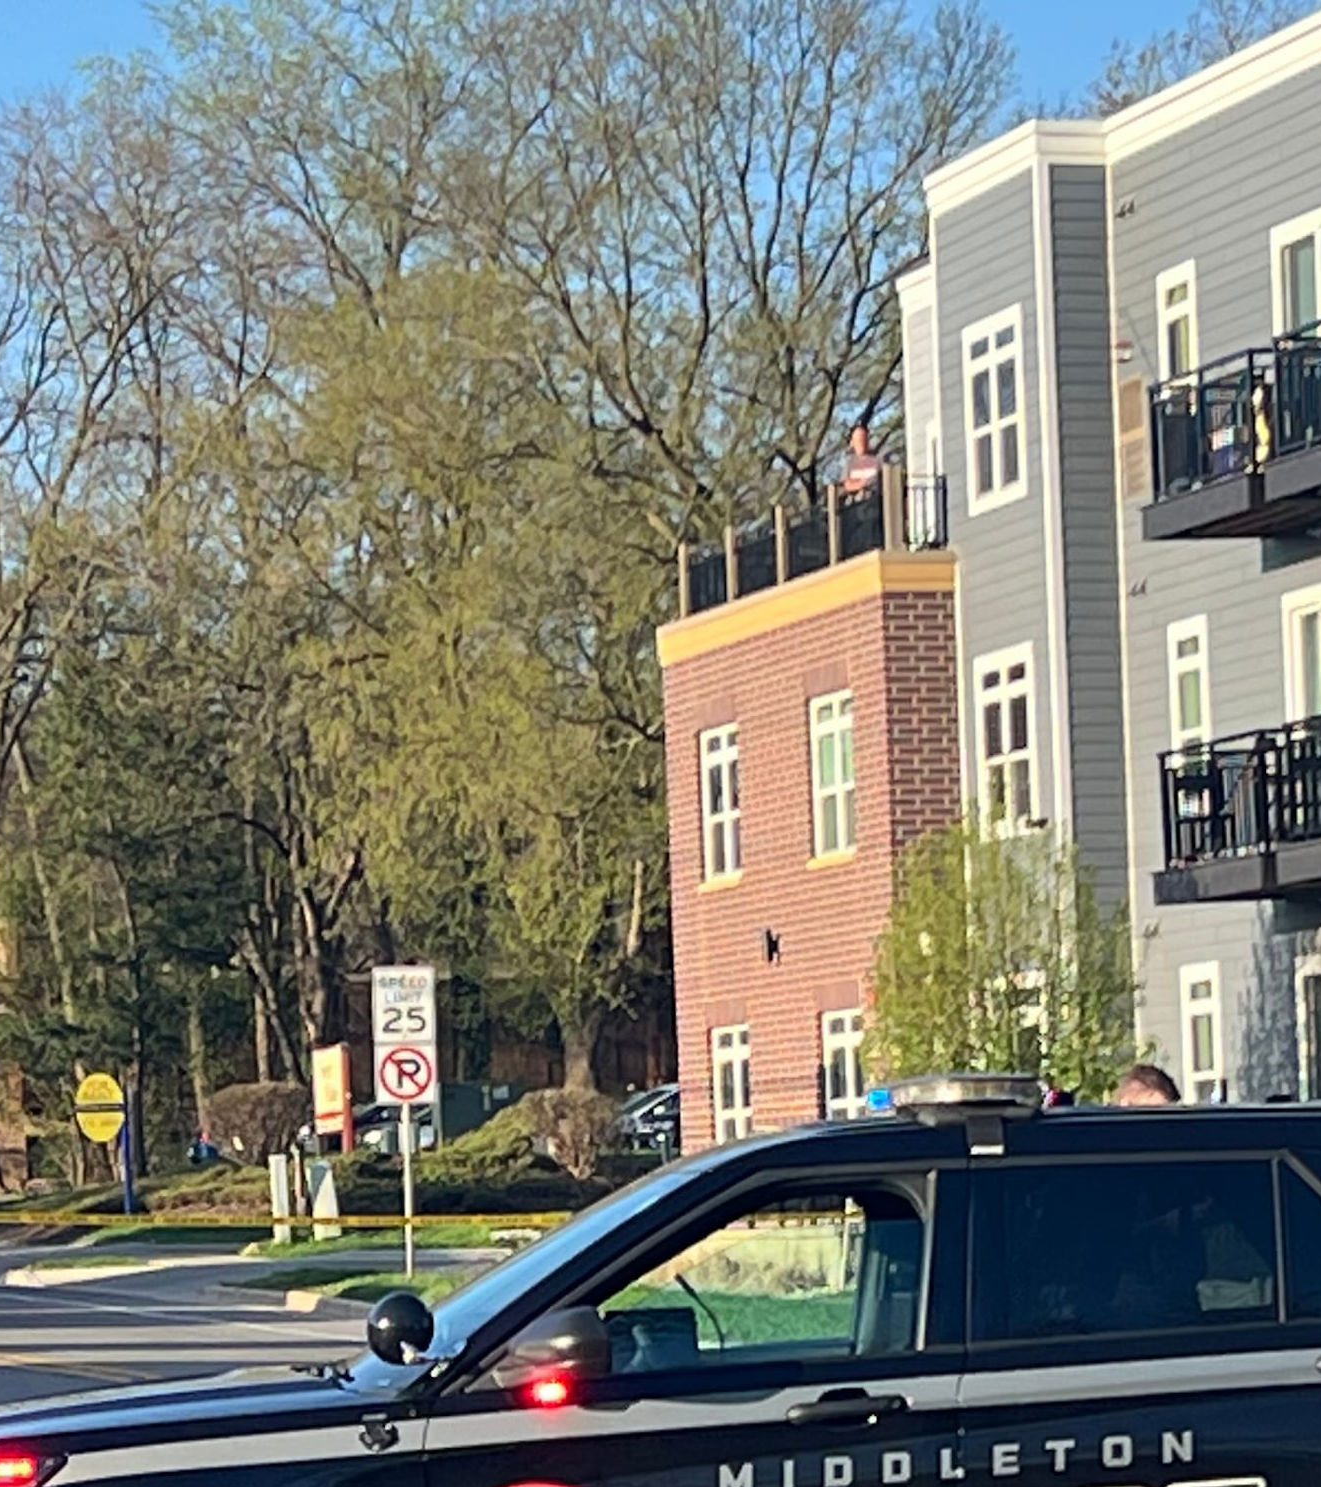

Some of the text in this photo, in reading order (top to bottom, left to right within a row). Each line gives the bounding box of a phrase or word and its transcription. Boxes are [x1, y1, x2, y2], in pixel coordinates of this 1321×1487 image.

[379, 975, 427, 988] SPEED
[384, 991, 423, 1004] LIMIT
[382, 1006, 426, 1033] 25
